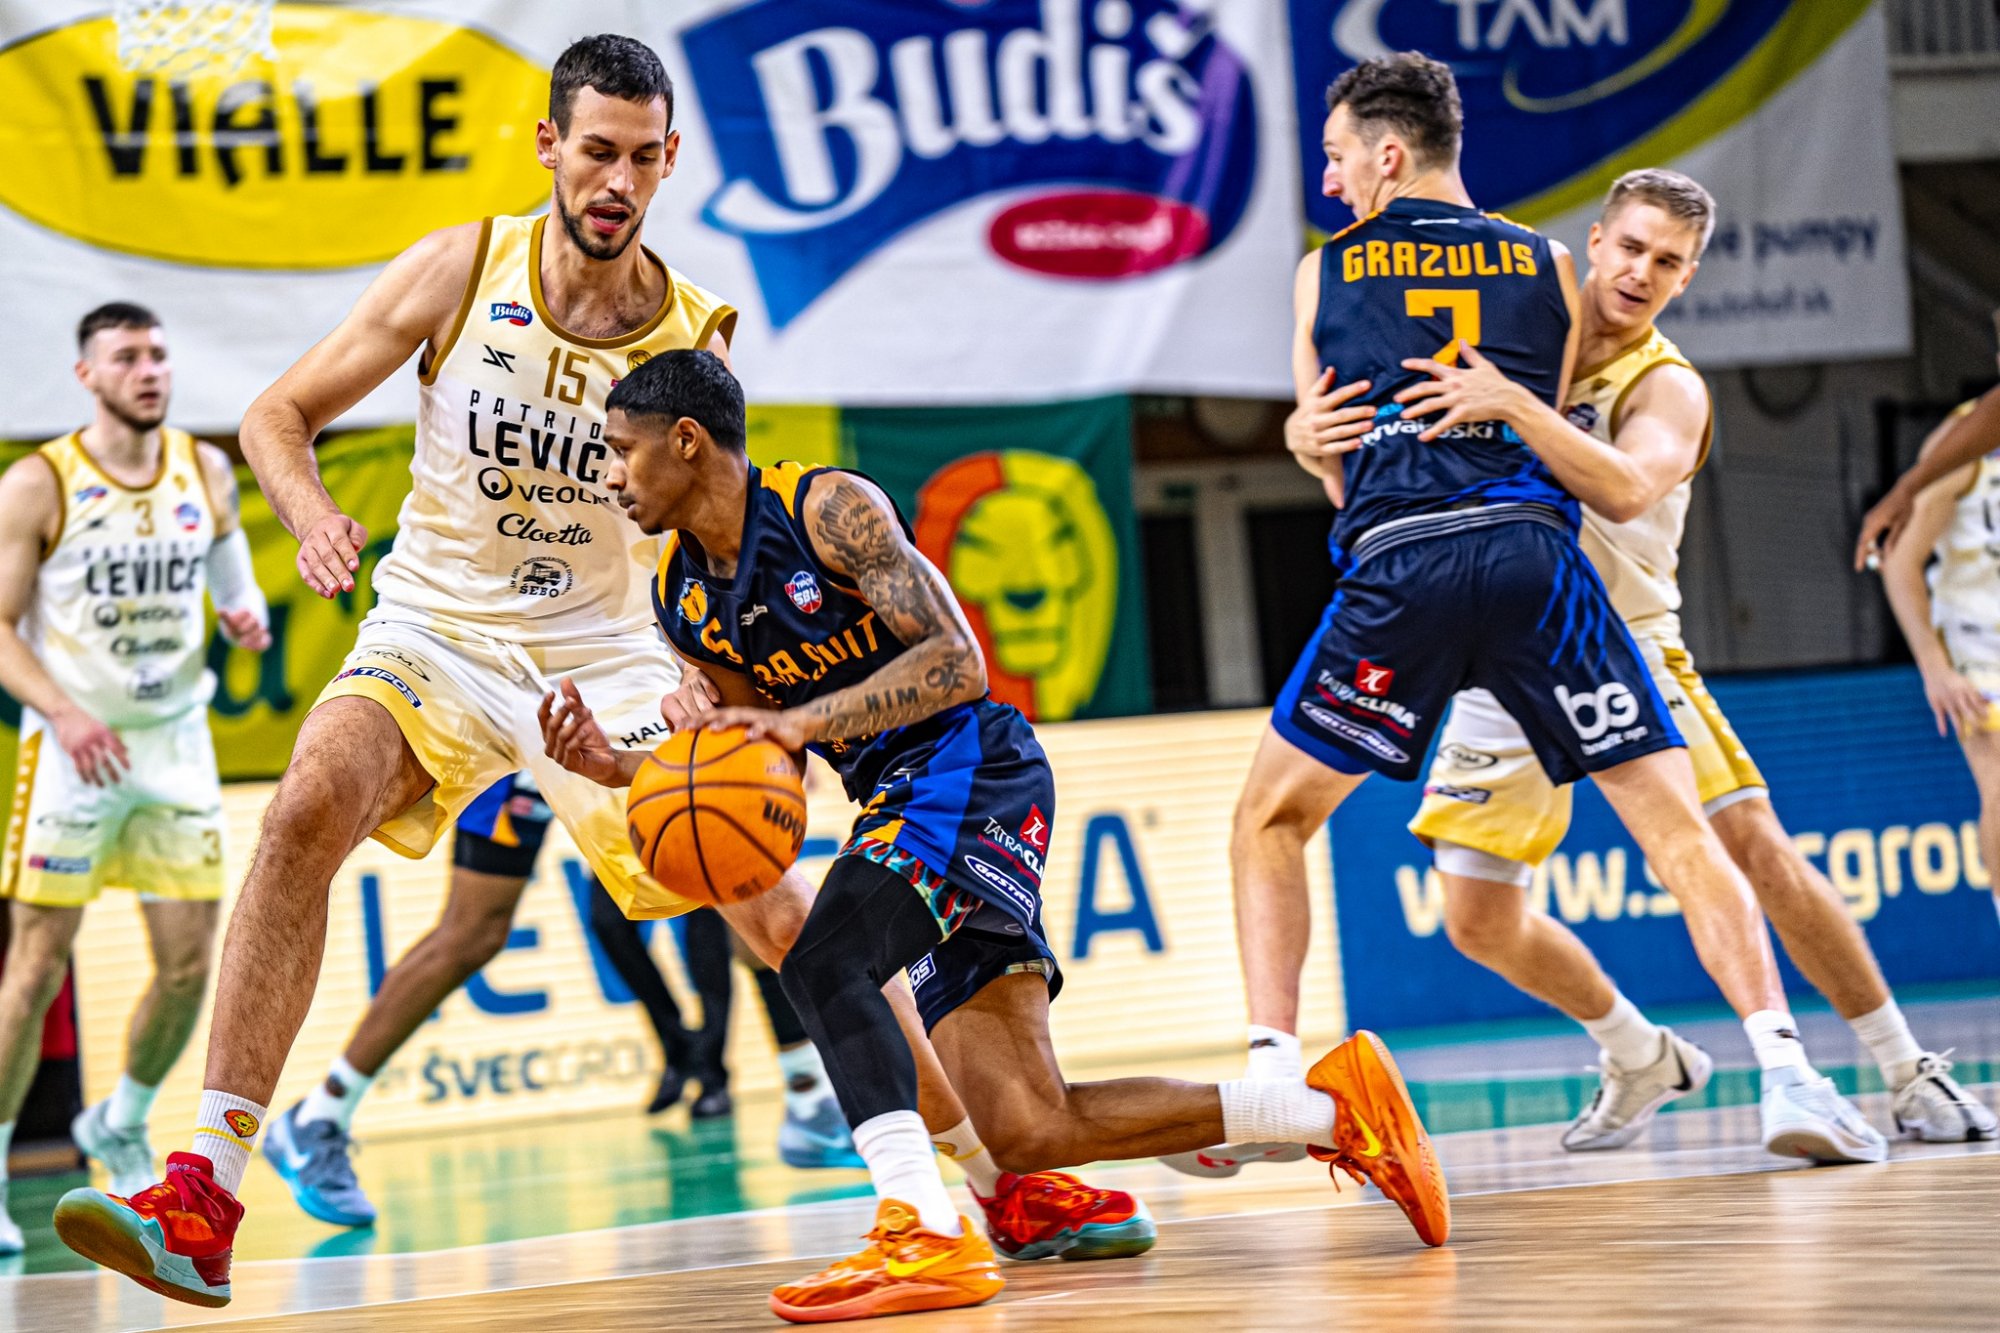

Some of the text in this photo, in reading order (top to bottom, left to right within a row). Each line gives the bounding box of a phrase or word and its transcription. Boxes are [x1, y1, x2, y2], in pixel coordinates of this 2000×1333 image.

[82, 74, 470, 188] VIALLE
[702, 0, 1208, 233] Budiš
[1343, 240, 1537, 282] GRAZULIS
[1404, 289, 1481, 382] 7
[543, 346, 591, 406] 15
[470, 389, 602, 439] PATRIO
[469, 410, 609, 483] LEVIC
[133, 498, 156, 538] 3
[497, 513, 593, 545] Cloetta
[360, 667, 416, 704] TIPOS
[620, 722, 668, 748] HAL
[984, 816, 1044, 880] TATRACL
[975, 863, 1034, 909] GASTRO
